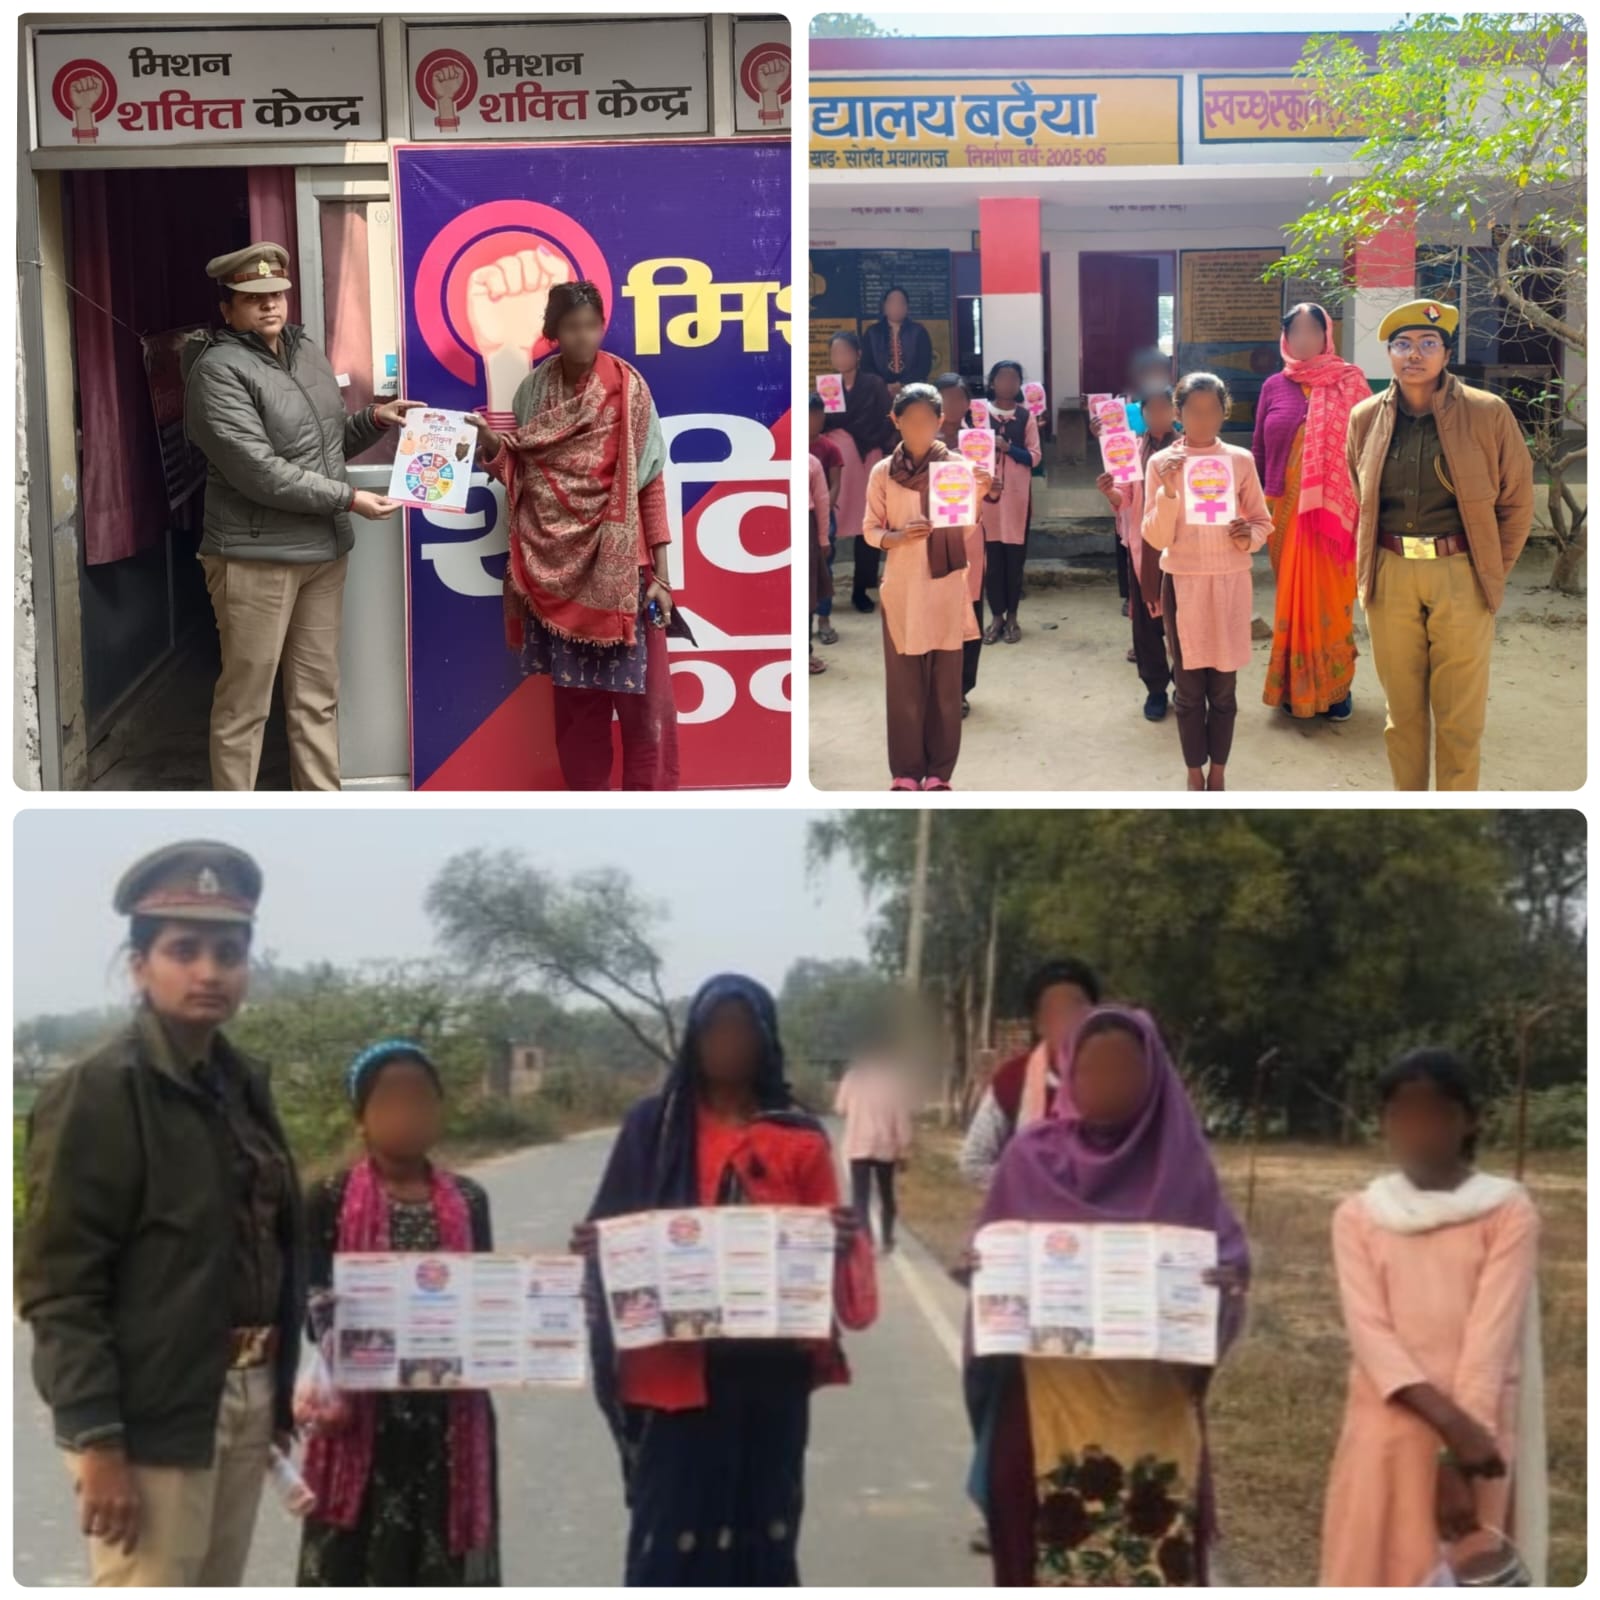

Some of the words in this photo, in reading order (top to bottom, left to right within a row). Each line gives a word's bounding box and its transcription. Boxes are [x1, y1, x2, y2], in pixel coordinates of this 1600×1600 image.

[129, 47, 232, 77] मिशन
[484, 47, 584, 78] मिशन
[117, 89, 246, 131] शक्ति
[253, 88, 364, 130] केन्द्र
[479, 81, 589, 123] शक्ति
[596, 79, 692, 121] केन्द्र
[960, 80, 1098, 146] बढ़ैया
[621, 257, 791, 355] मि
